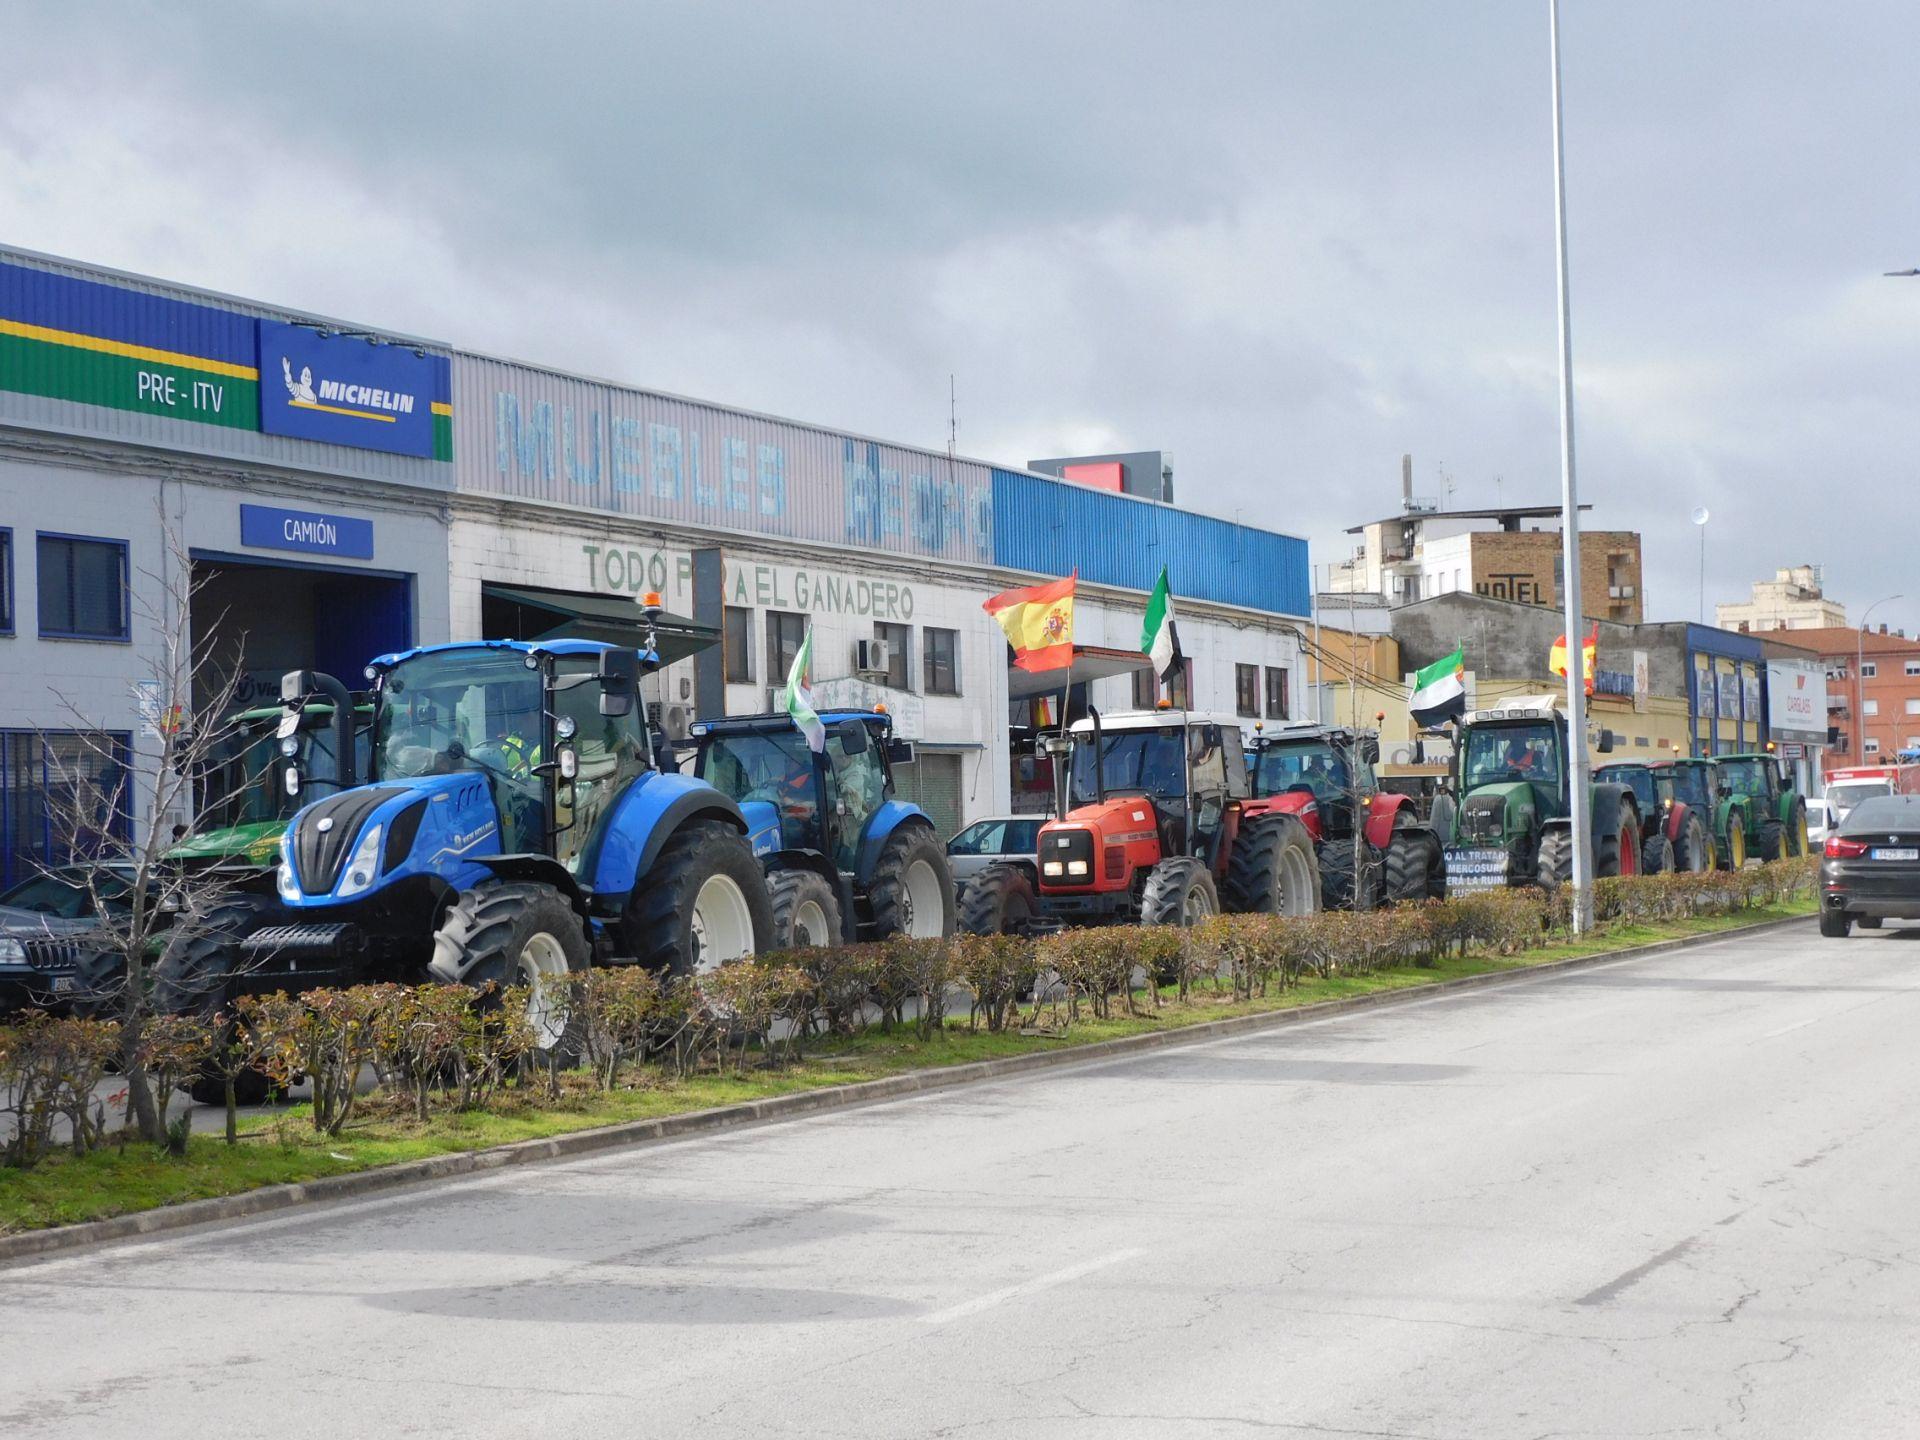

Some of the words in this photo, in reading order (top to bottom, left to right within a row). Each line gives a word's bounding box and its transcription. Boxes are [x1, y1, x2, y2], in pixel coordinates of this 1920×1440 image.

[138, 371, 176, 405] PRE
[193, 381, 223, 413] ITV
[319, 379, 414, 414] MICHELIN
[496, 390, 786, 519] MUEBLES
[284, 518, 337, 545] CAMIÓN
[582, 545, 668, 593] TODO
[676, 556, 749, 604] PA
[755, 566, 788, 607] EL
[794, 571, 915, 620] GANADERO
[1476, 573, 1547, 604] HOTEL
[1455, 851, 1467, 861] AL
[1446, 874, 1465, 886] ERÁ
[1466, 876, 1479, 886] LA
